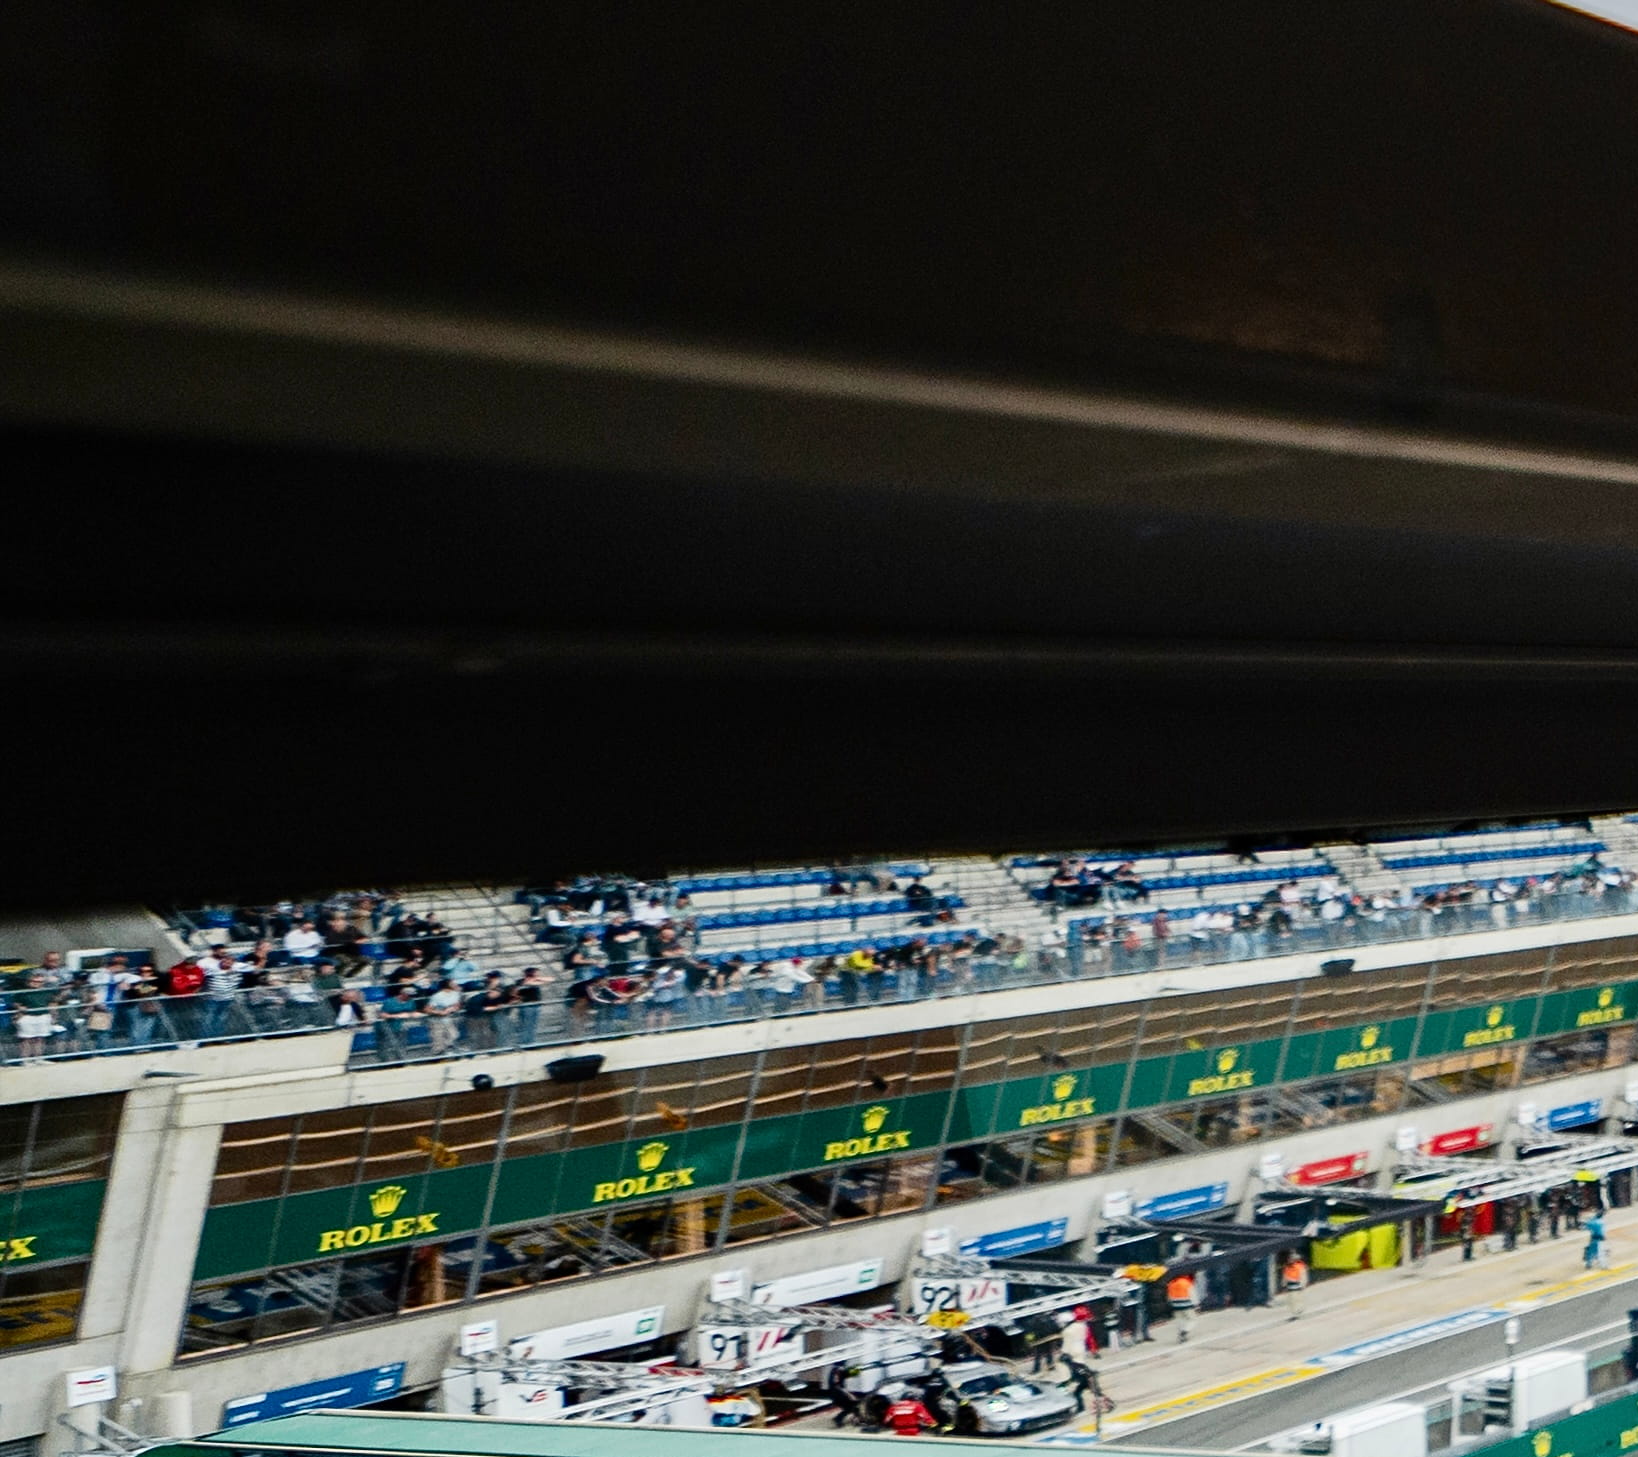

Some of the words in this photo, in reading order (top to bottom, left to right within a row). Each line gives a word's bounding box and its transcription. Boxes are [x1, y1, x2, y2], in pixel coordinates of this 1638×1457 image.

[1188, 1070, 1255, 1096] ROLEX
[1020, 1096, 1095, 1127] ROLEX
[824, 1129, 911, 1161] ROLEX
[593, 1166, 696, 1204] ROLEX
[318, 1212, 439, 1252] ROLEX
